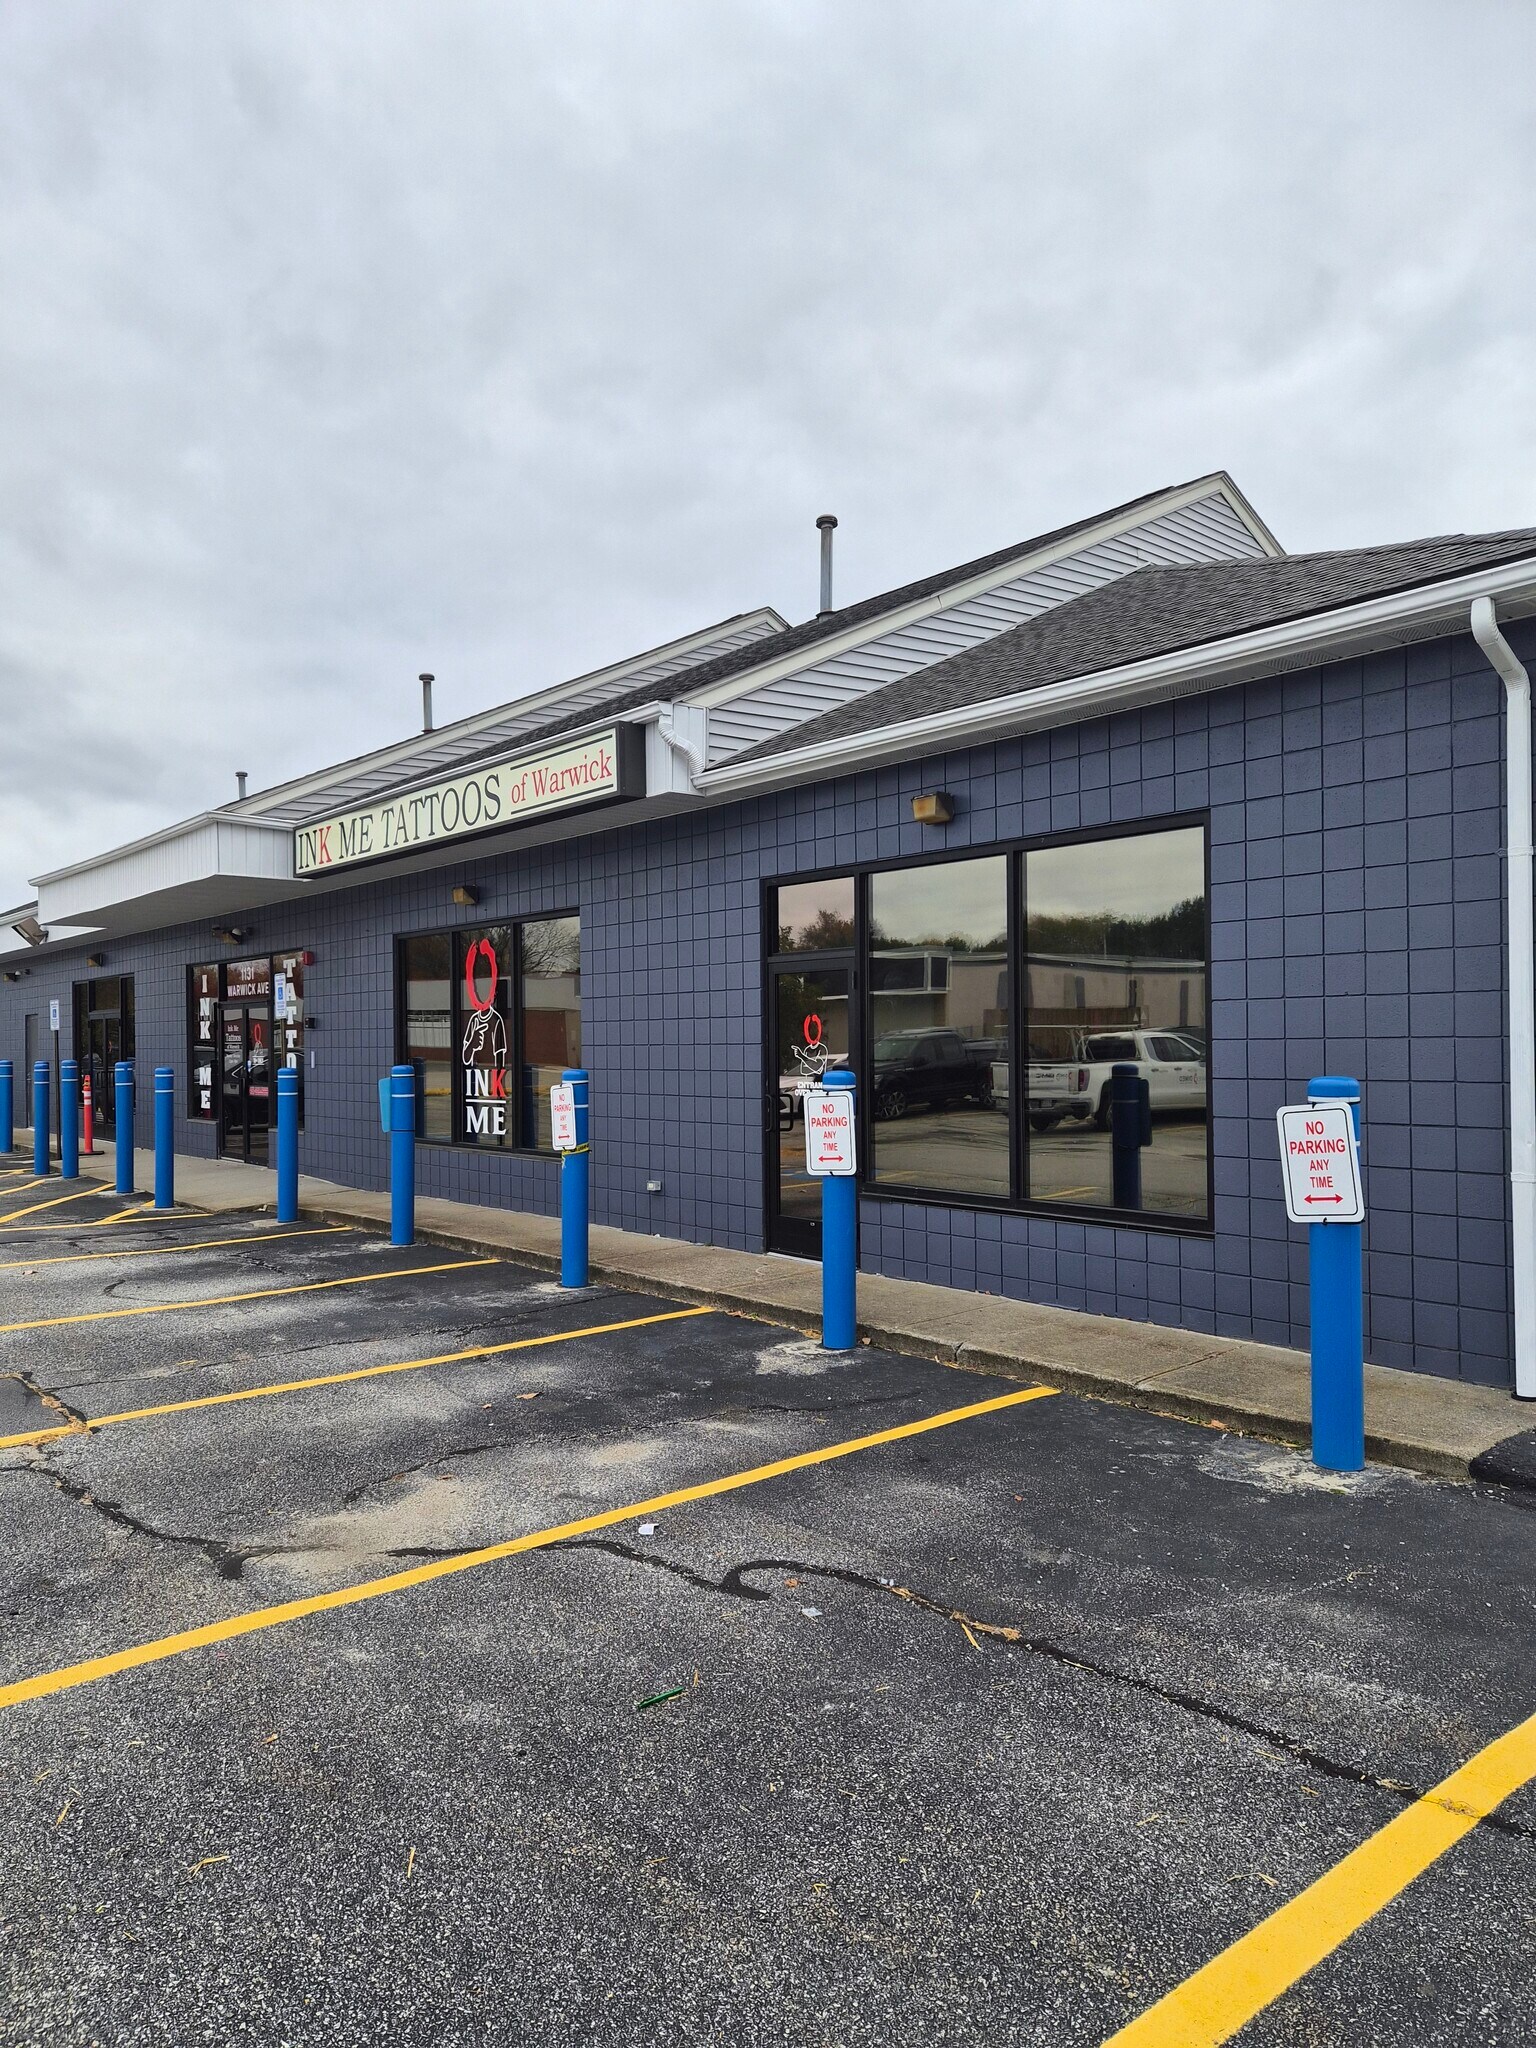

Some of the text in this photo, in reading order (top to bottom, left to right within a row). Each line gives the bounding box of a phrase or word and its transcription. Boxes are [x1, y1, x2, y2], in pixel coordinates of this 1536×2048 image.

[510, 748, 613, 804] of Warwick
[298, 773, 500, 870] INK ME TATTOOS
[241, 966, 255, 981] 1131
[227, 984, 256, 997] WARWICK
[256, 981, 270, 995] AVE
[283, 958, 298, 1068] TATTO
[465, 1069, 507, 1098] INK
[797, 1081, 823, 1089] ENTRAN
[558, 1094, 566, 1102] NO
[554, 1103, 572, 1113] PARKING
[822, 1104, 834, 1114] NO
[466, 1106, 507, 1135] ME
[811, 1116, 848, 1127] PARKING
[823, 1130, 837, 1139] ANY
[1305, 1121, 1324, 1135] NO
[823, 1142, 838, 1151] TIME
[1290, 1138, 1346, 1154] PARKING
[1309, 1159, 1329, 1171] ANY
[1309, 1176, 1333, 1188] TIME
